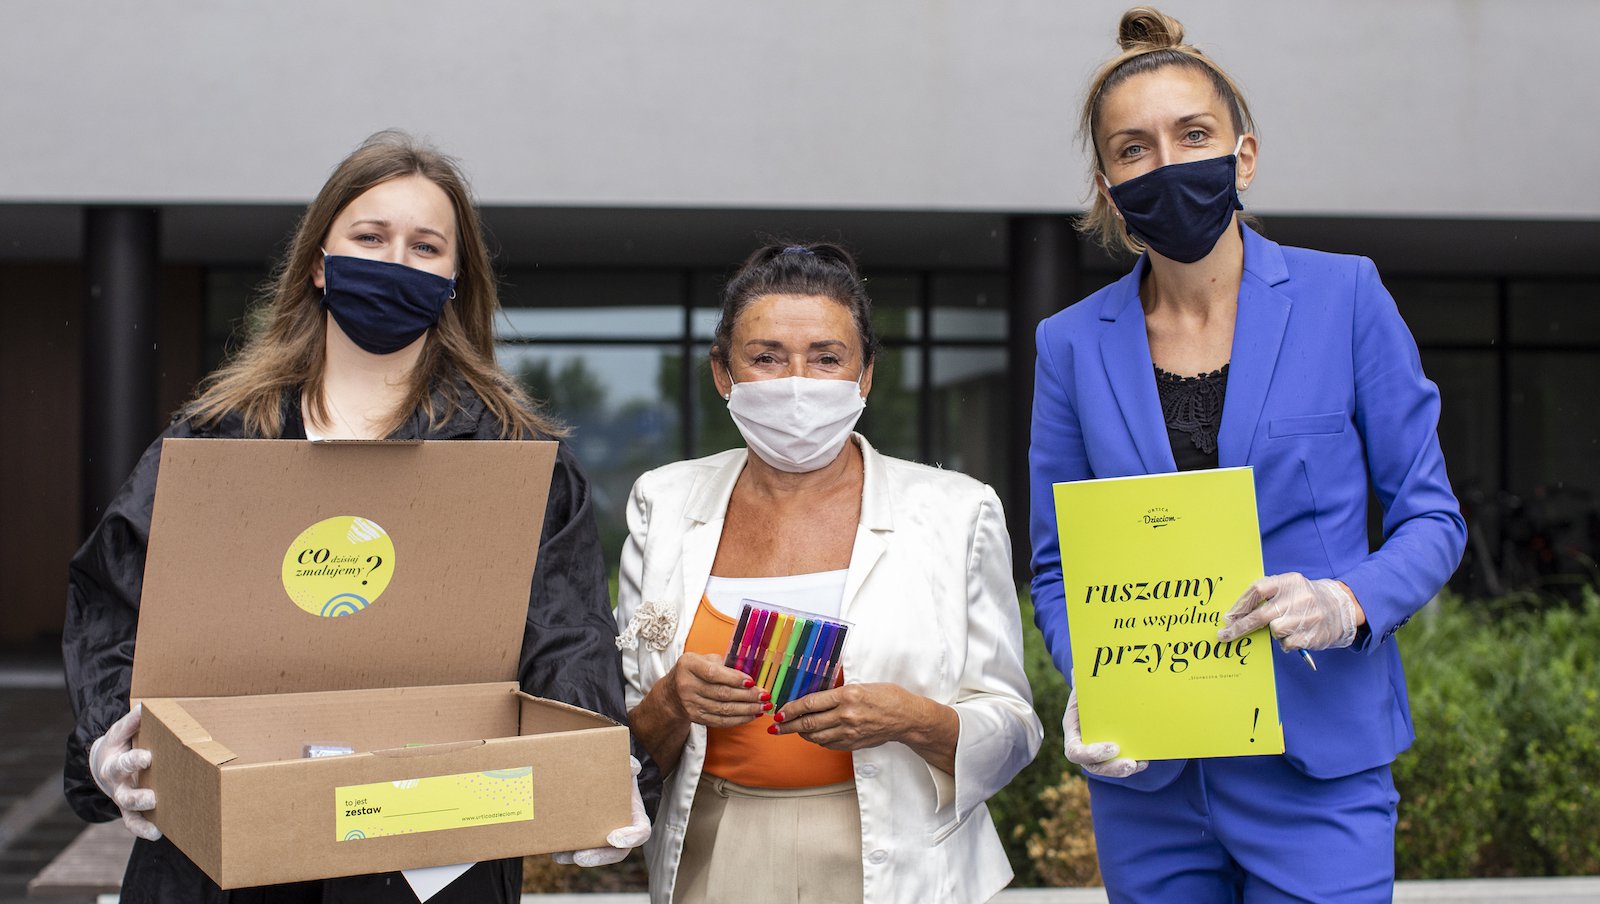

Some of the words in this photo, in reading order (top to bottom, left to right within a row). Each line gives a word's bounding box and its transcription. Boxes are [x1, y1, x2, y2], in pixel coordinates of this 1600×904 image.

[1142, 514, 1176, 525] Dzieciom
[297, 547, 331, 565] co
[330, 555, 360, 564] dzisiaj
[295, 565, 365, 579] zmalujemy
[1085, 576, 1223, 606] ruszamy
[1113, 616, 1137, 630] na
[1142, 606, 1221, 632] wspólną
[1249, 707, 1260, 743] !
[354, 798, 368, 807] jest
[345, 806, 382, 817] zestaw
